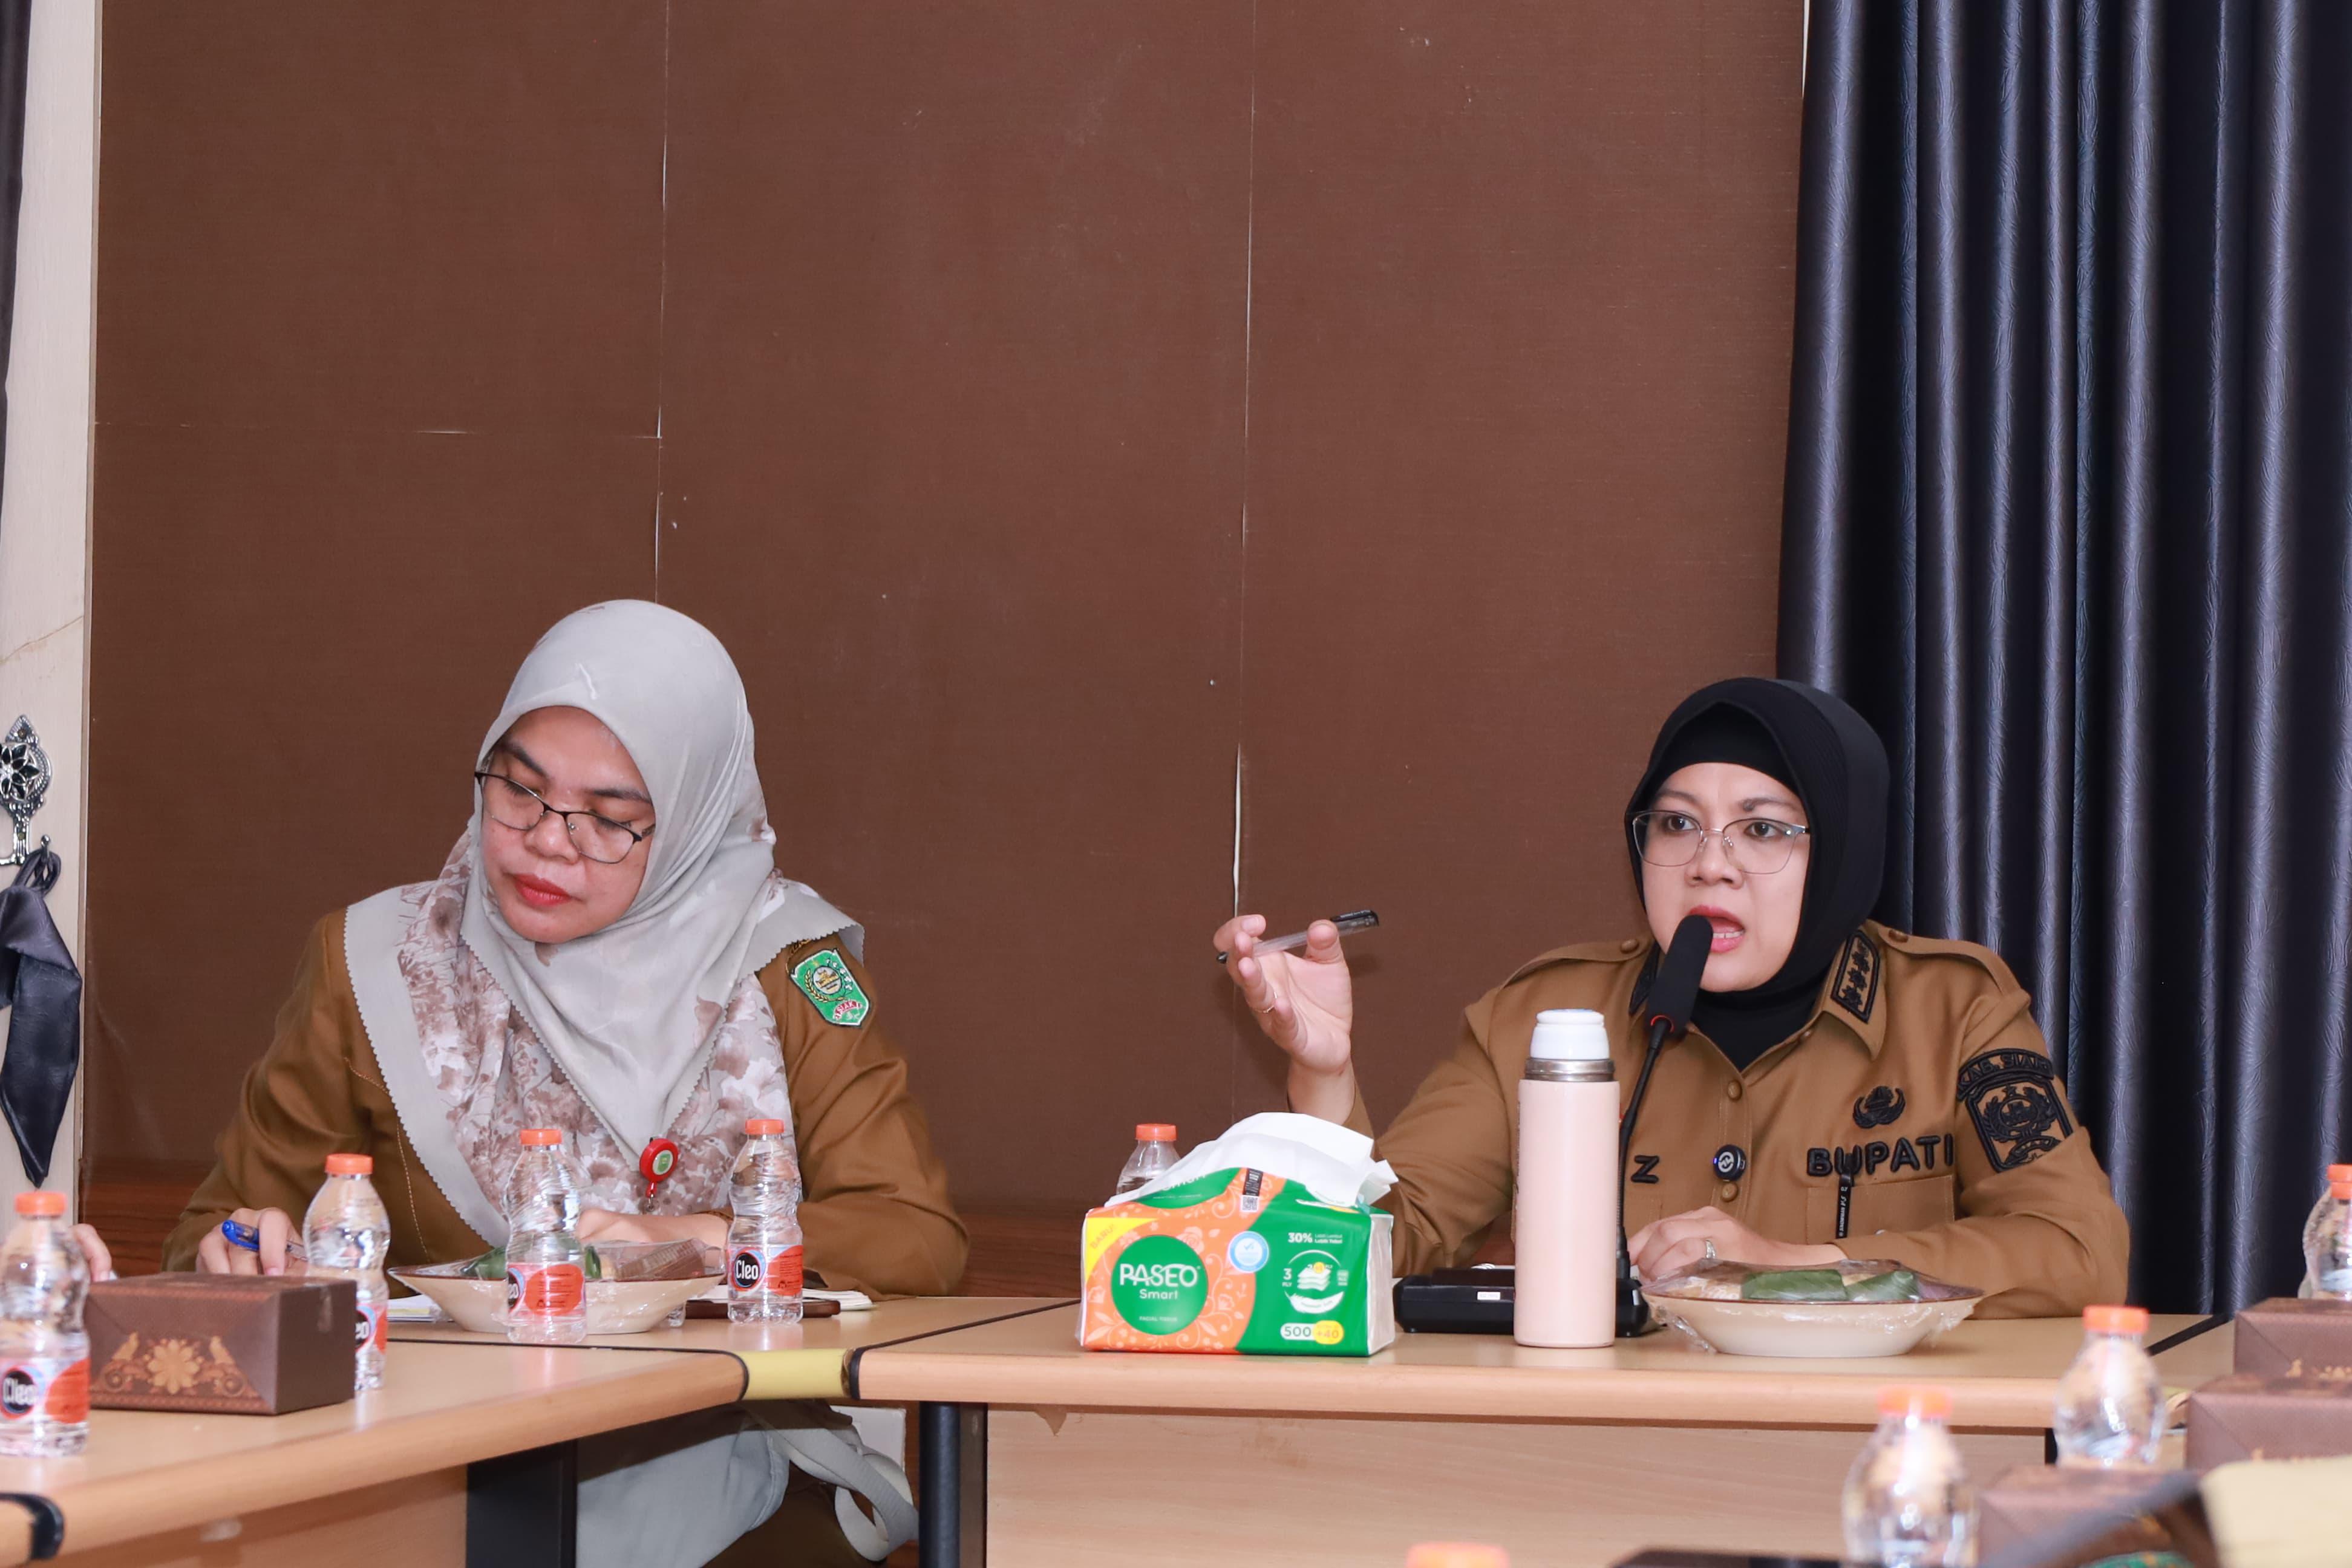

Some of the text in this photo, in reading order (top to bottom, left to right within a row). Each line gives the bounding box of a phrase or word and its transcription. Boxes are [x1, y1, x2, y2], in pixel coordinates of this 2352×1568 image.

[1807, 1133, 1955, 1177] BUPATI
[1631, 1155, 1659, 1184] Z
[1287, 1232, 1313, 1243] 30%
[736, 1260, 759, 1279] Cleo
[1120, 1263, 1198, 1287] PASEO
[1283, 1268, 1292, 1280] 3
[508, 1283, 520, 1299] eo
[1139, 1289, 1178, 1299] Smart
[355, 1321, 370, 1339] eo
[1284, 1326, 1312, 1337] 500
